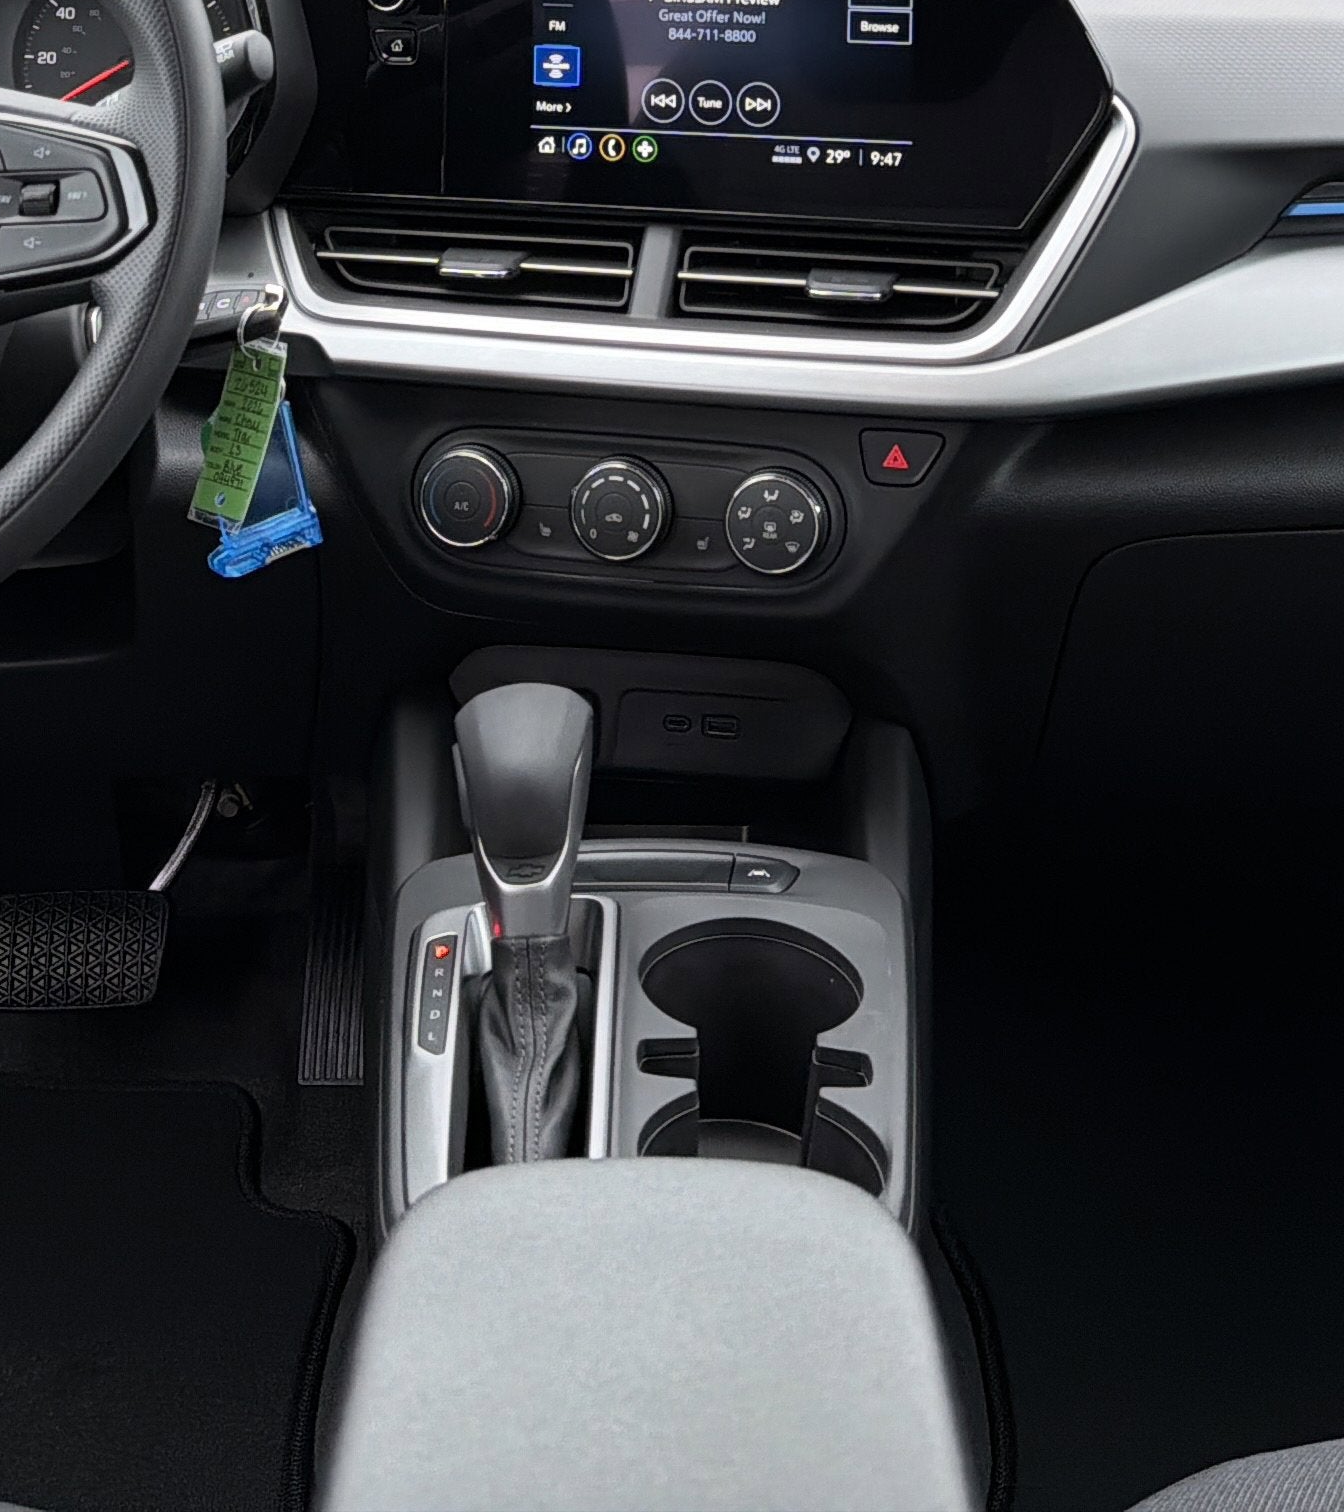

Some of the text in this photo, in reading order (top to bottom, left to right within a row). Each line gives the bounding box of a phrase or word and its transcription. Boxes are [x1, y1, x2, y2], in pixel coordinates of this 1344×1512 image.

[55, 6, 76, 20] 40
[658, 8, 766, 25] Great Offer Now!
[548, 20, 566, 32] FM
[860, 20, 900, 34] Browse
[668, 27, 757, 44] 844-711-8800
[37, 51, 57, 65] 20
[535, 100, 564, 113] More
[697, 96, 723, 110] Tune
[870, 150, 903, 167] 9:47
[453, 499, 471, 513] A/C
[434, 967, 445, 978] R
[431, 988, 444, 999] N
[429, 1009, 442, 1021] D
[427, 1030, 437, 1042] L
